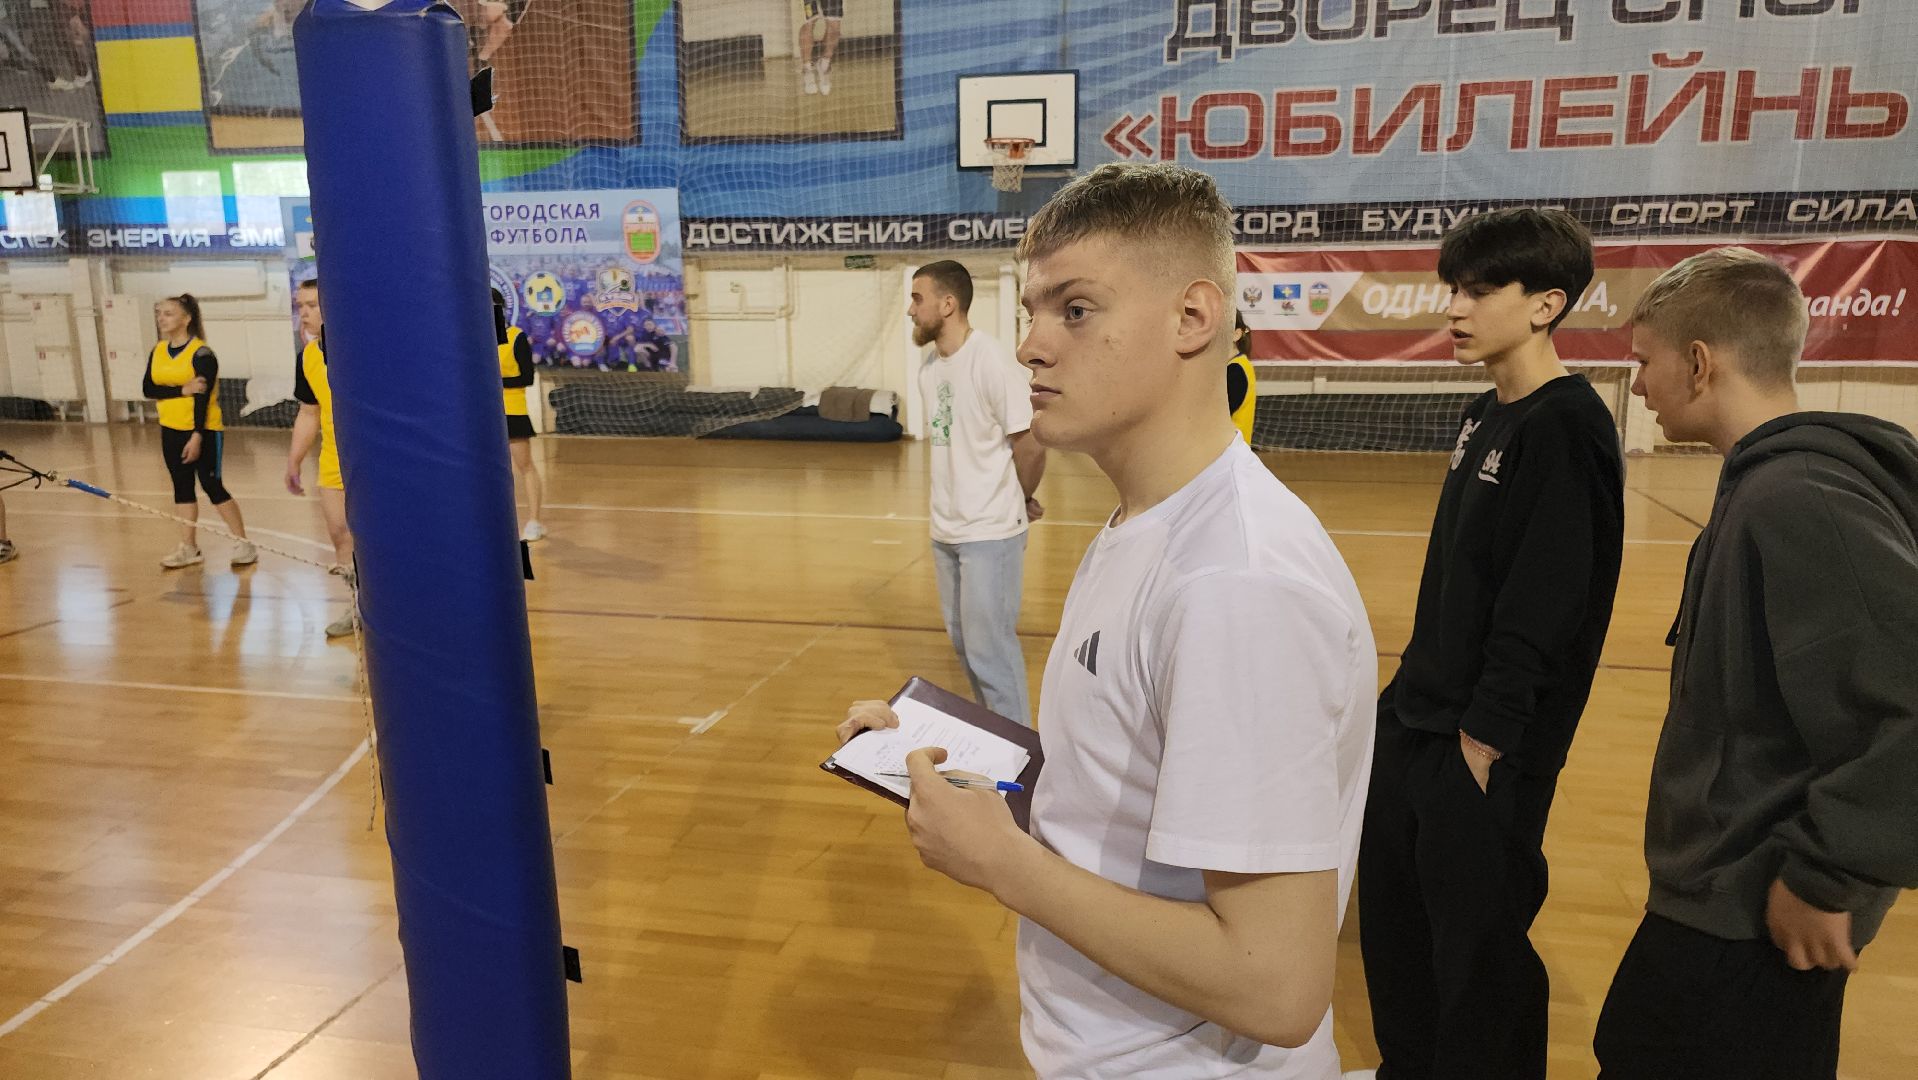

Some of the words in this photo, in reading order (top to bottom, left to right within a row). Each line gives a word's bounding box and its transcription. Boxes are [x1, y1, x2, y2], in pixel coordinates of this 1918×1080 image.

[88, 227, 212, 248] ЭНЕРГИЯ
[686, 220, 924, 248] ДОСТИЖЕНИЯ
[948, 218, 1034, 242] СМЕ
[1610, 200, 1756, 225] СПОРТ
[1787, 197, 1918, 223] СИЛА
[490, 227, 588, 244] ФУТБОЛА
